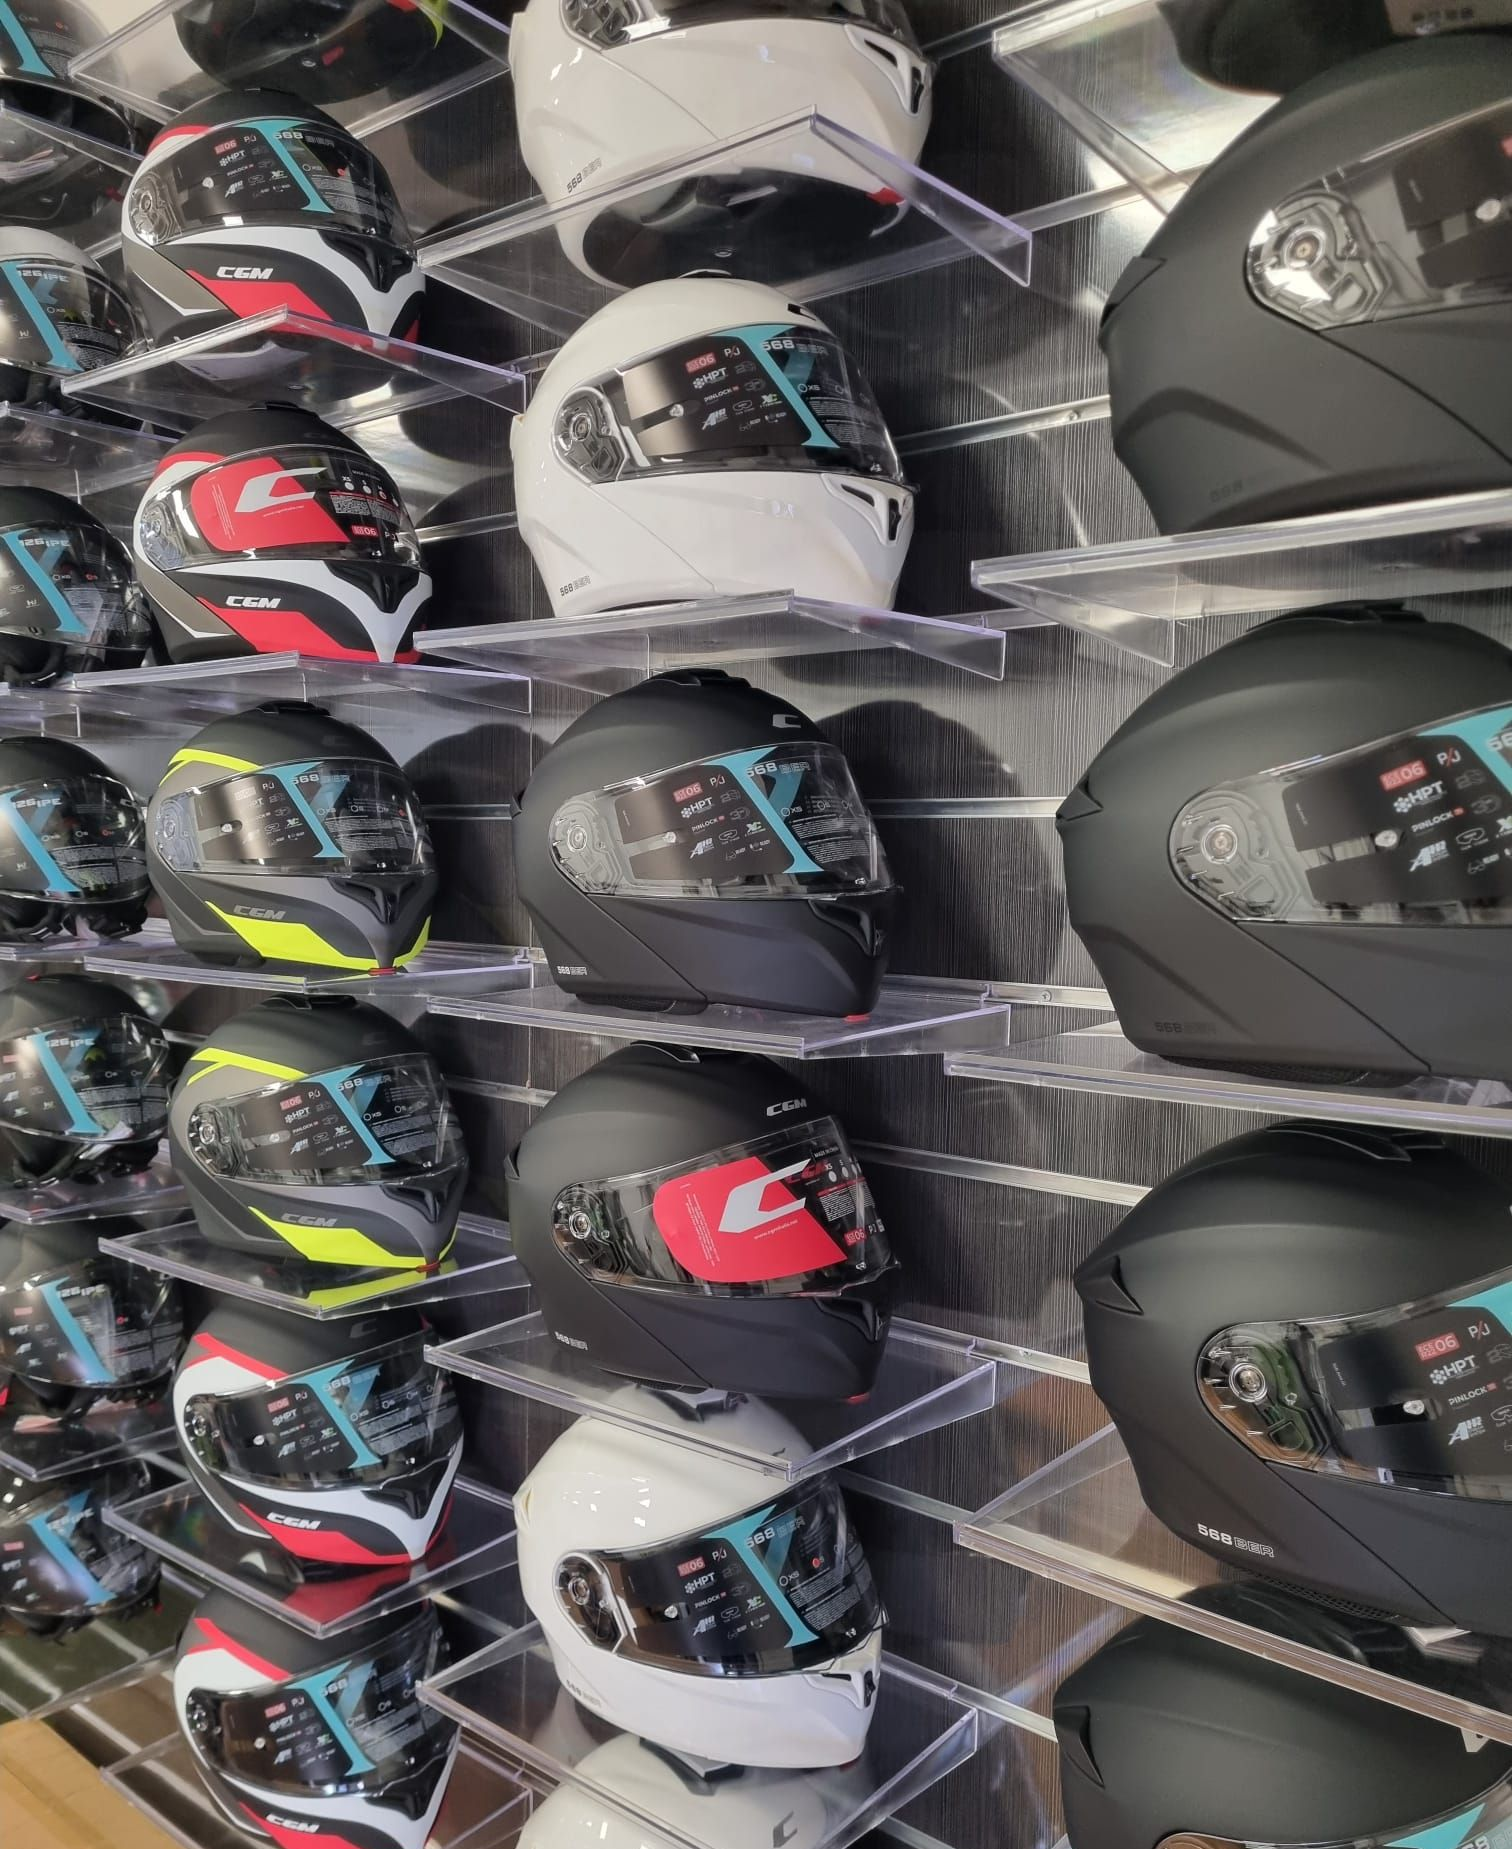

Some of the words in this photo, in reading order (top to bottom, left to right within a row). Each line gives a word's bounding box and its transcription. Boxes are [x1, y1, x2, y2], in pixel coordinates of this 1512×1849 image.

[216, 266, 274, 280] CGM
[702, 367, 727, 383] HPT
[226, 595, 282, 609] CGM
[1401, 761, 1422, 779] 06
[1408, 780, 1443, 804] HPT
[690, 797, 713, 812] HPT
[1411, 810, 1453, 833] PINLOCK
[233, 904, 287, 920] CGM
[766, 1098, 807, 1117] CGM
[1434, 1335, 1457, 1352] 06
[1443, 1355, 1476, 1377] HPT
[1448, 1386, 1488, 1406] PINLOCK
[694, 1572, 716, 1589] HPT
